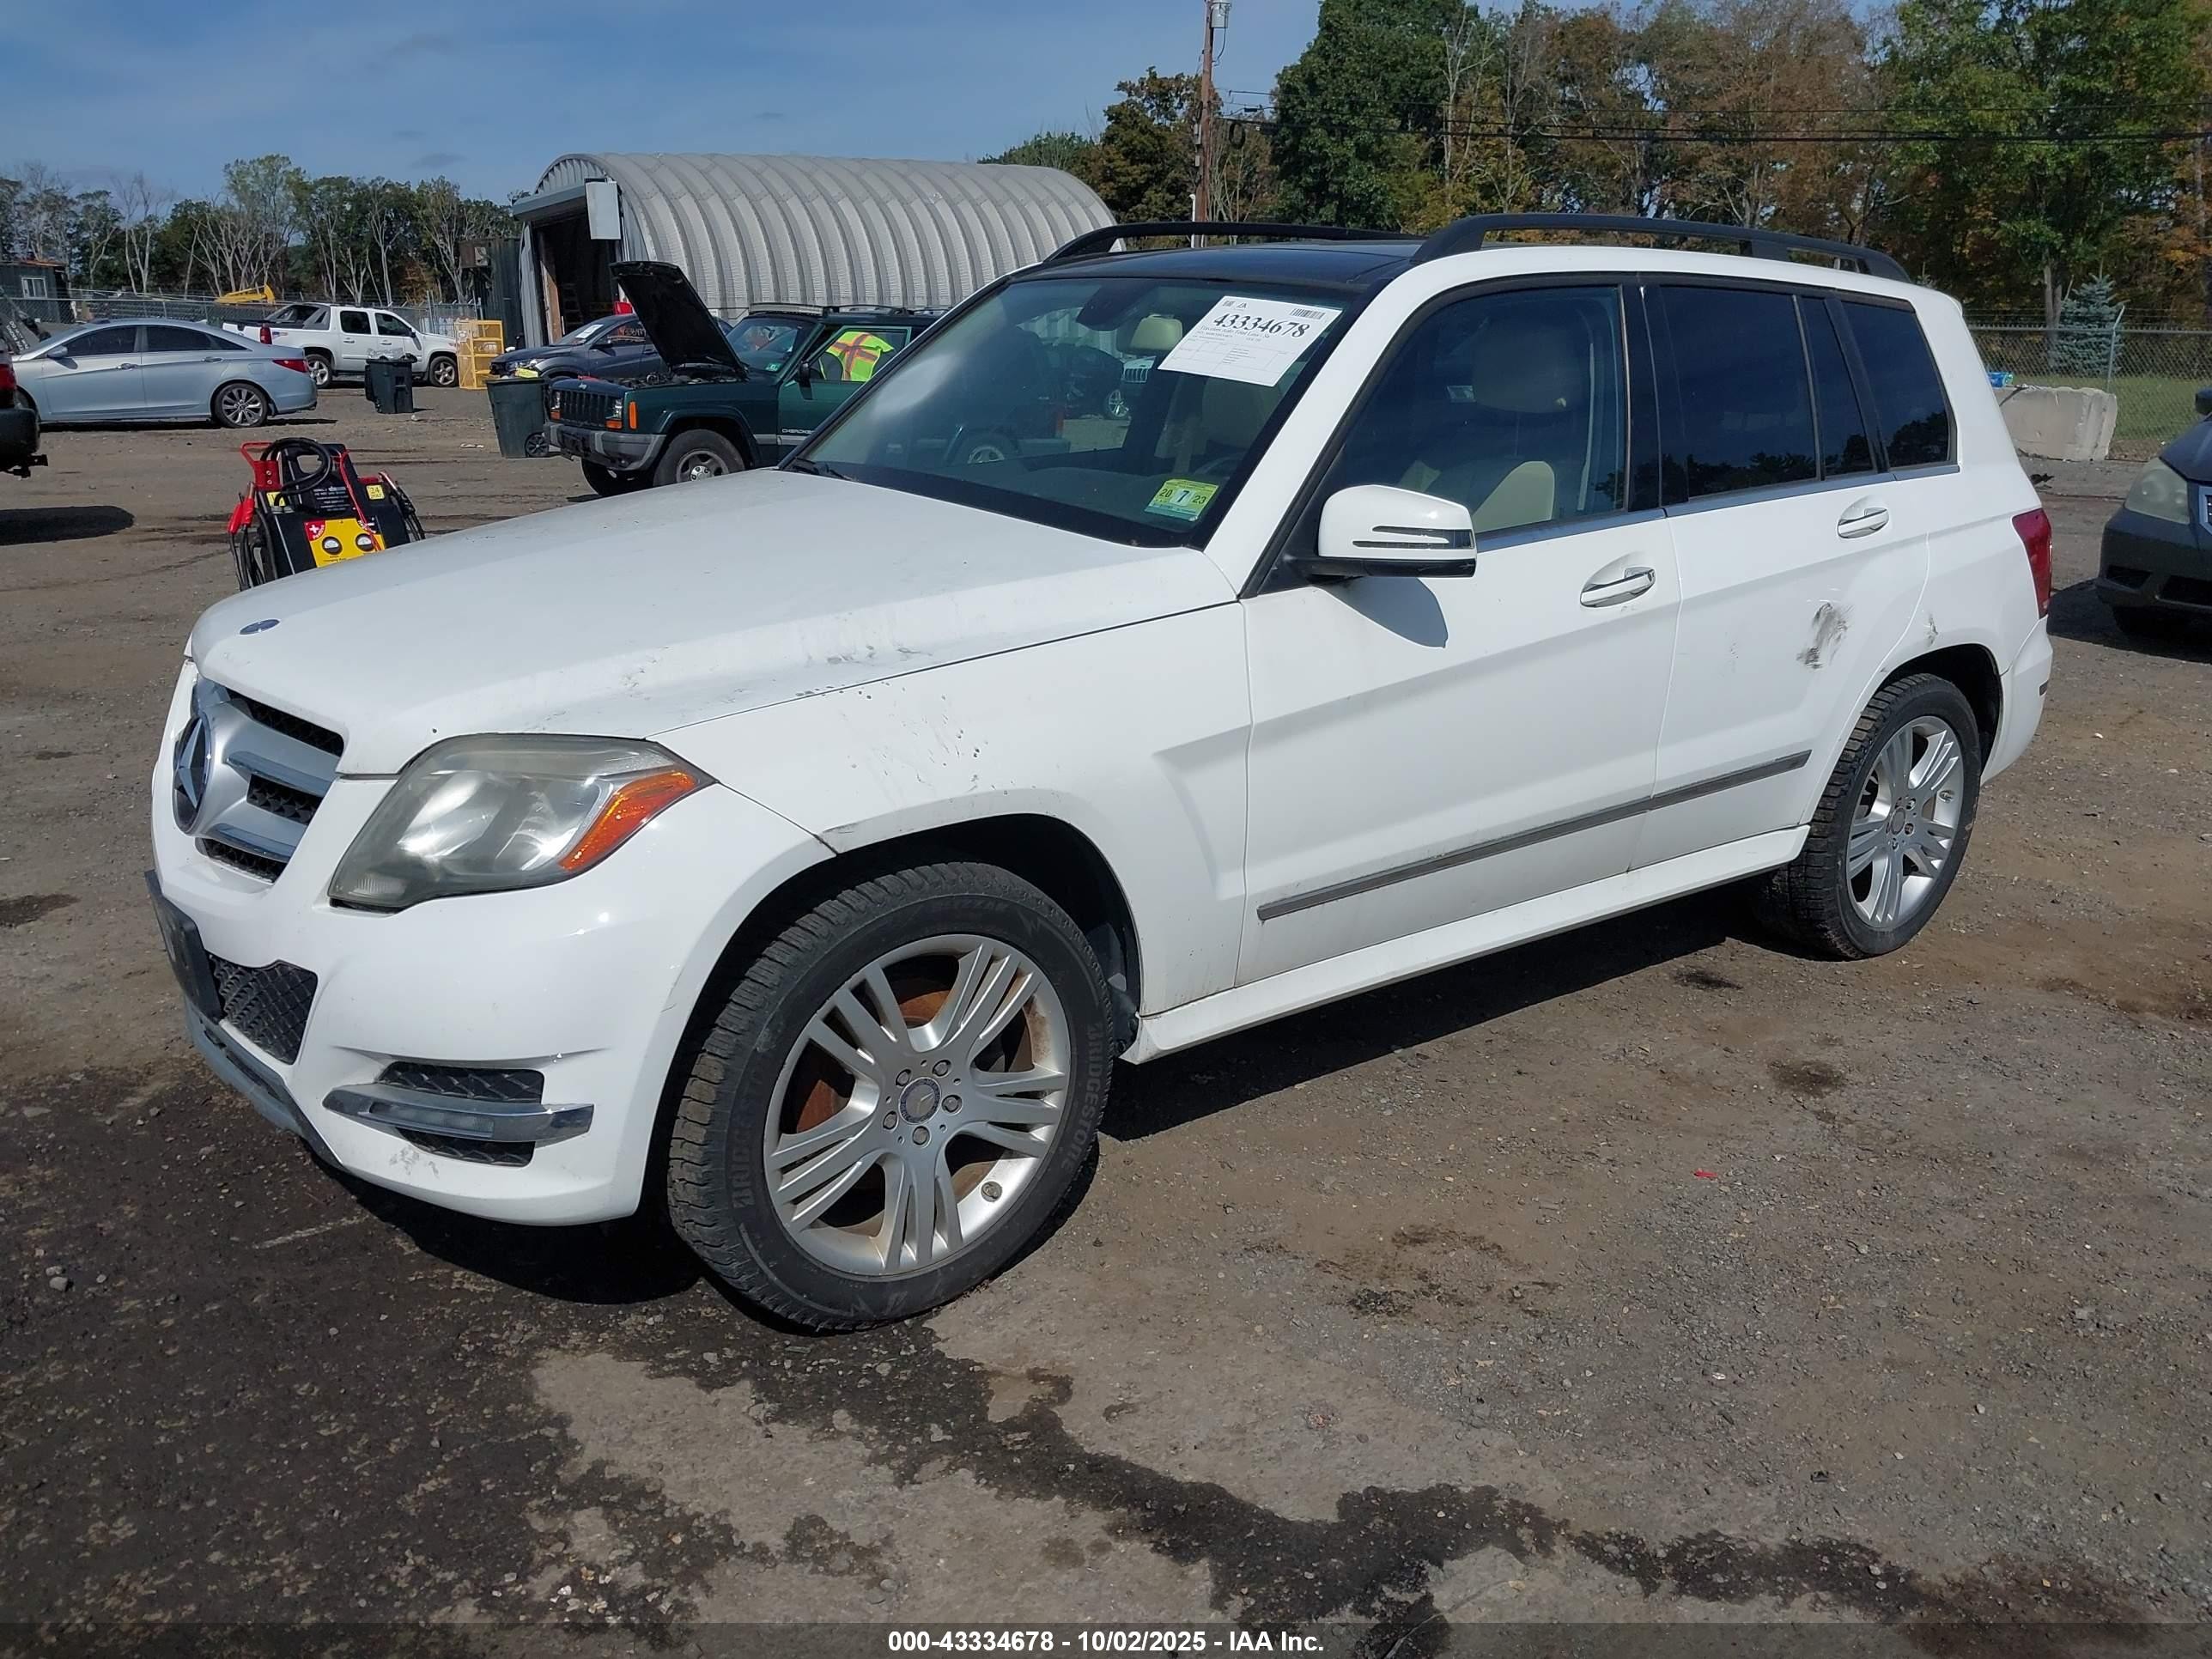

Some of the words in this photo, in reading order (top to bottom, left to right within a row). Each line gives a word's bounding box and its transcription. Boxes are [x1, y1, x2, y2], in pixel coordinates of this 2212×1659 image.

[1212, 313, 1310, 338] 43334678
[1159, 488, 1173, 498] 20
[1176, 489, 1190, 502] 7
[1192, 495, 1207, 505] 23
